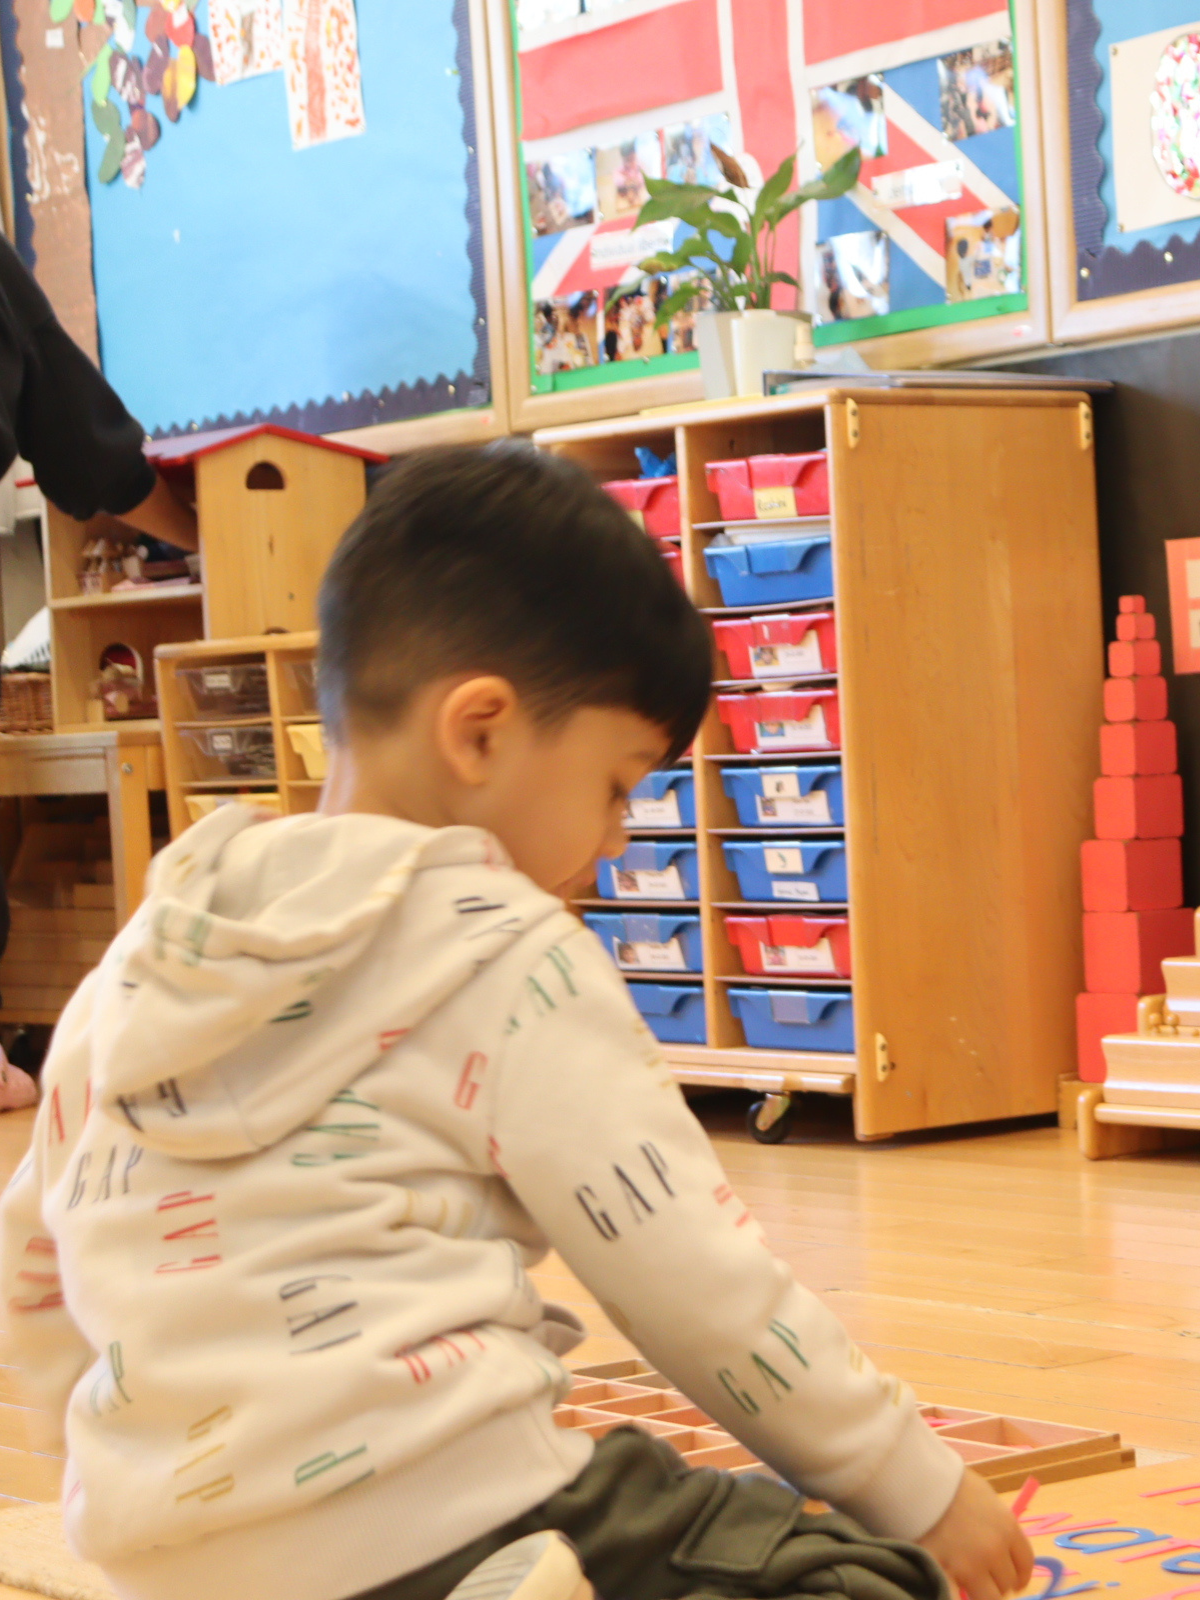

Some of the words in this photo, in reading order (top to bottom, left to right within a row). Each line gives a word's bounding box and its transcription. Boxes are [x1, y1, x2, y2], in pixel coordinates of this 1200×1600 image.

[67, 1143, 144, 1212] GAP
[574, 1140, 676, 1242] GAP
[154, 1190, 223, 1274] GAP
[717, 1317, 811, 1418] GAP
